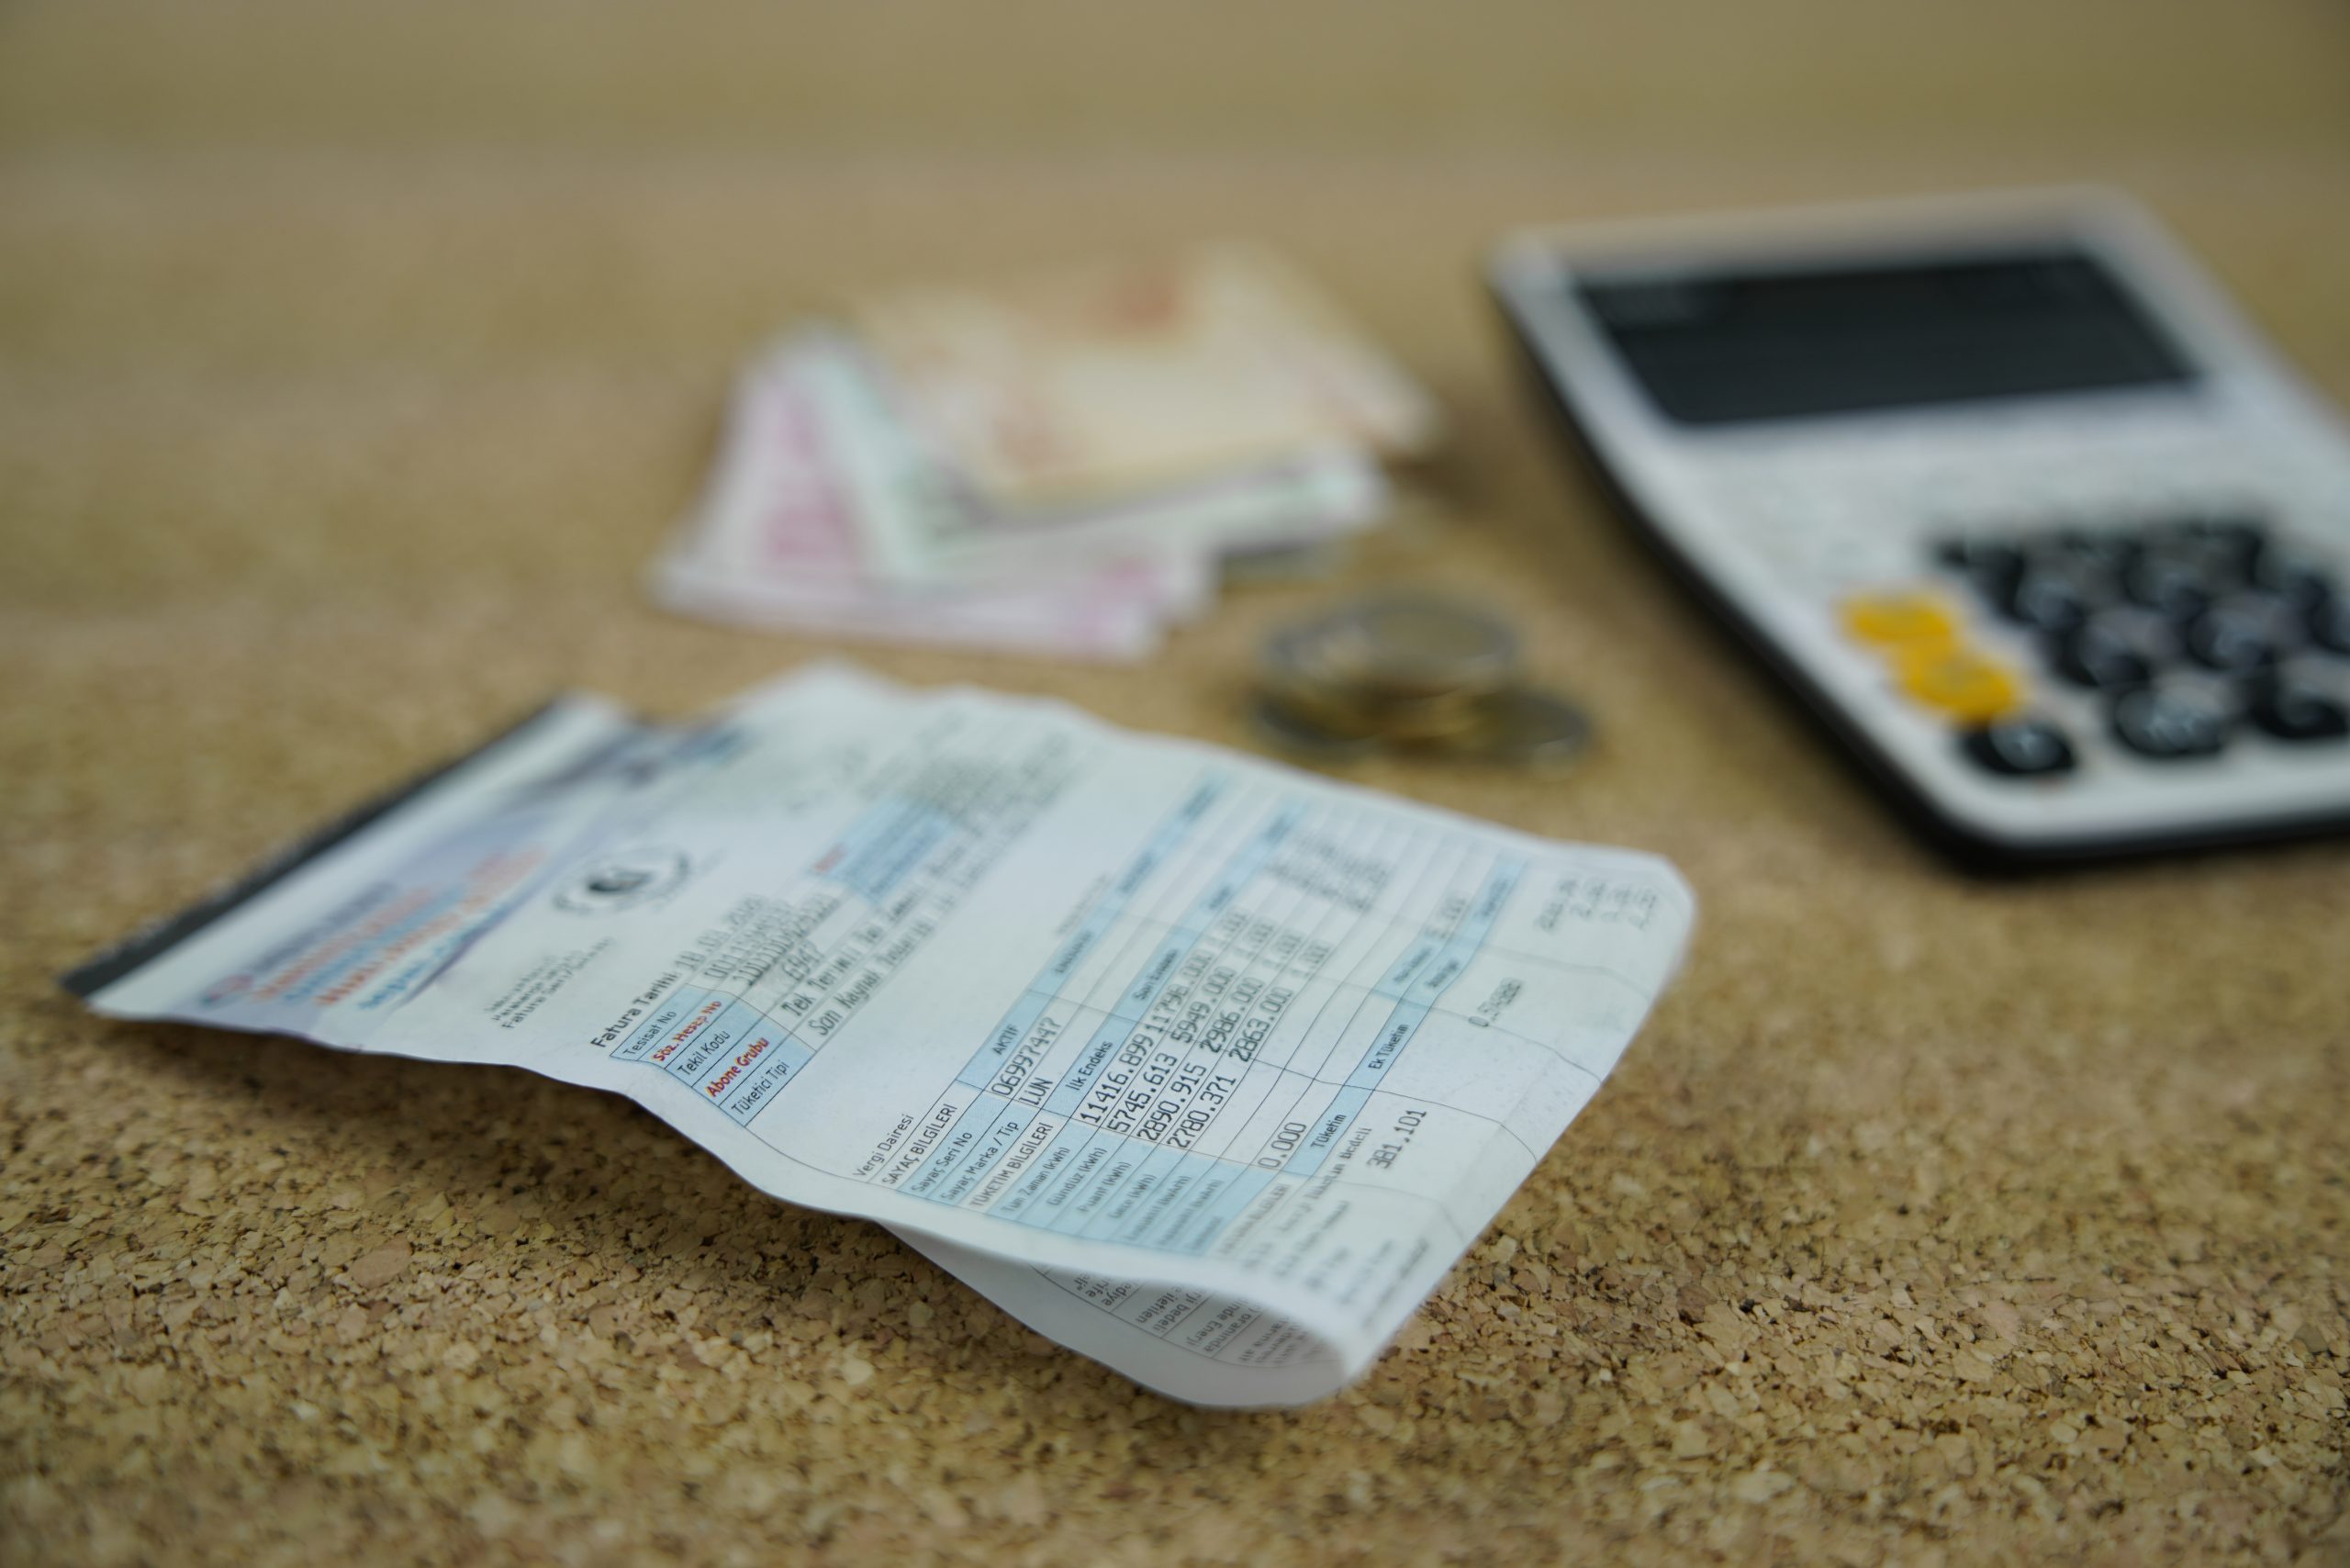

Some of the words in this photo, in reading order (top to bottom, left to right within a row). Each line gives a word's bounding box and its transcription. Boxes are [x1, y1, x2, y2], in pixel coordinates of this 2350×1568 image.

[780, 991, 817, 1018] Tek
[807, 1009, 844, 1036] Son
[590, 1006, 642, 1047] Fatura
[623, 1024, 657, 1057] Tesisat
[659, 1010, 677, 1025] No
[653, 1042, 680, 1062] Söz.
[701, 999, 722, 1016] No
[1375, 1024, 1410, 1057] Tüketim
[677, 1047, 705, 1076] Tekil
[702, 1030, 732, 1057] Kodu
[705, 1063, 742, 1098] Abone
[734, 1036, 771, 1068] Grubu
[1078, 1039, 1113, 1077] Endeks
[1106, 1052, 1178, 1133] 5745.613
[1169, 964, 1237, 1045] 5949.000
[1136, 1061, 1208, 1141] 2890.915
[1199, 976, 1266, 1054] 2986.000
[1166, 1074, 1237, 1148] 2780.371
[1228, 986, 1294, 1063] 2863.000
[1367, 1057, 1387, 1070] Ek
[730, 1075, 774, 1115] Tüketici
[765, 1059, 790, 1084] Tipi
[1080, 1033, 1155, 1124] 11416.899
[852, 1151, 886, 1179] Vergi
[877, 1113, 915, 1152] Dairesi
[881, 1153, 921, 1185] SAYAÇ
[910, 1103, 958, 1156] BİLGİLERİ
[991, 1137, 1003, 1147] /
[996, 1120, 1021, 1138] Tip
[1257, 1121, 1307, 1170] 0.000
[1309, 1114, 1348, 1149] Tüketim
[1366, 1109, 1427, 1170] 381.101
[911, 1166, 946, 1193] Sayaç
[934, 1146, 961, 1168] Seri
[953, 1131, 973, 1148] No
[967, 1146, 1000, 1175] Marka
[968, 1168, 1015, 1209] TÜKETİM
[1006, 1122, 1055, 1170] BİLGİLERİ
[1018, 1170, 1051, 1197] Zaman
[1043, 1147, 1071, 1171] (kWh)
[1080, 1147, 1109, 1173] (kWh)
[1104, 1161, 1133, 1188] (kWh)
[940, 1174, 974, 1201] Sayaç
[1129, 1173, 1158, 1202] (kWh)
[1136, 1292, 1176, 1324] iletilen
[1152, 1303, 1191, 1333] bedeli
[1186, 1320, 1224, 1347] Enerji
[1204, 1313, 1252, 1352] oranında
